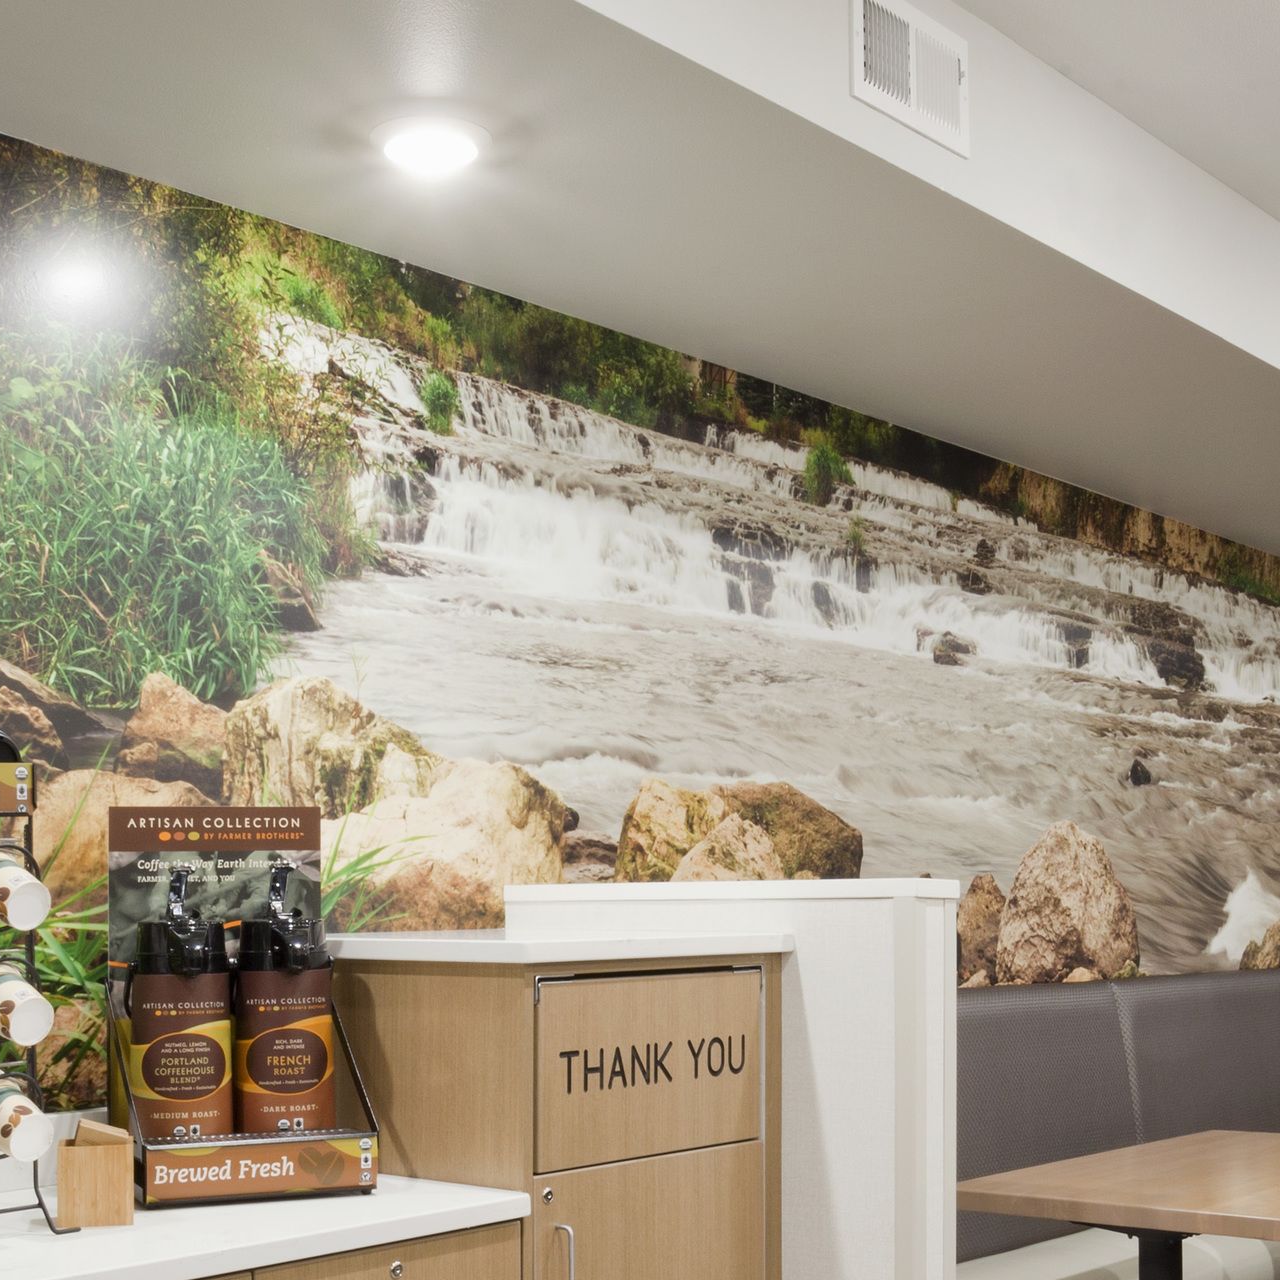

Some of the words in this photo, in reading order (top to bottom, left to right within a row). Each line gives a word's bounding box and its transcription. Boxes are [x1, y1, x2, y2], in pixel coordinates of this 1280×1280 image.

[127, 817, 194, 828] ARTISAN
[202, 817, 301, 828] COLLECTION
[204, 832, 214, 840] BY
[218, 832, 252, 840] FARMER
[137, 858, 169, 871] Coffee
[217, 858, 245, 869] Earth
[177, 1001, 224, 1009] COLLECTION
[280, 997, 326, 1005] COLLECTION
[161, 1057, 209, 1066] PORTLAND
[267, 1055, 311, 1066] FRENCH
[559, 1041, 673, 1095] THANK
[687, 1034, 745, 1080] YOU
[154, 1066, 215, 1076] COFFEEHOUSE
[273, 1066, 306, 1076] ROAST
[263, 1105, 287, 1113] DARK
[290, 1104, 316, 1112] ROAST
[153, 1112, 189, 1120] MEDIUM
[192, 1110, 218, 1119] ROAST
[154, 1159, 232, 1185] Brewed
[238, 1156, 295, 1180] Fresh
